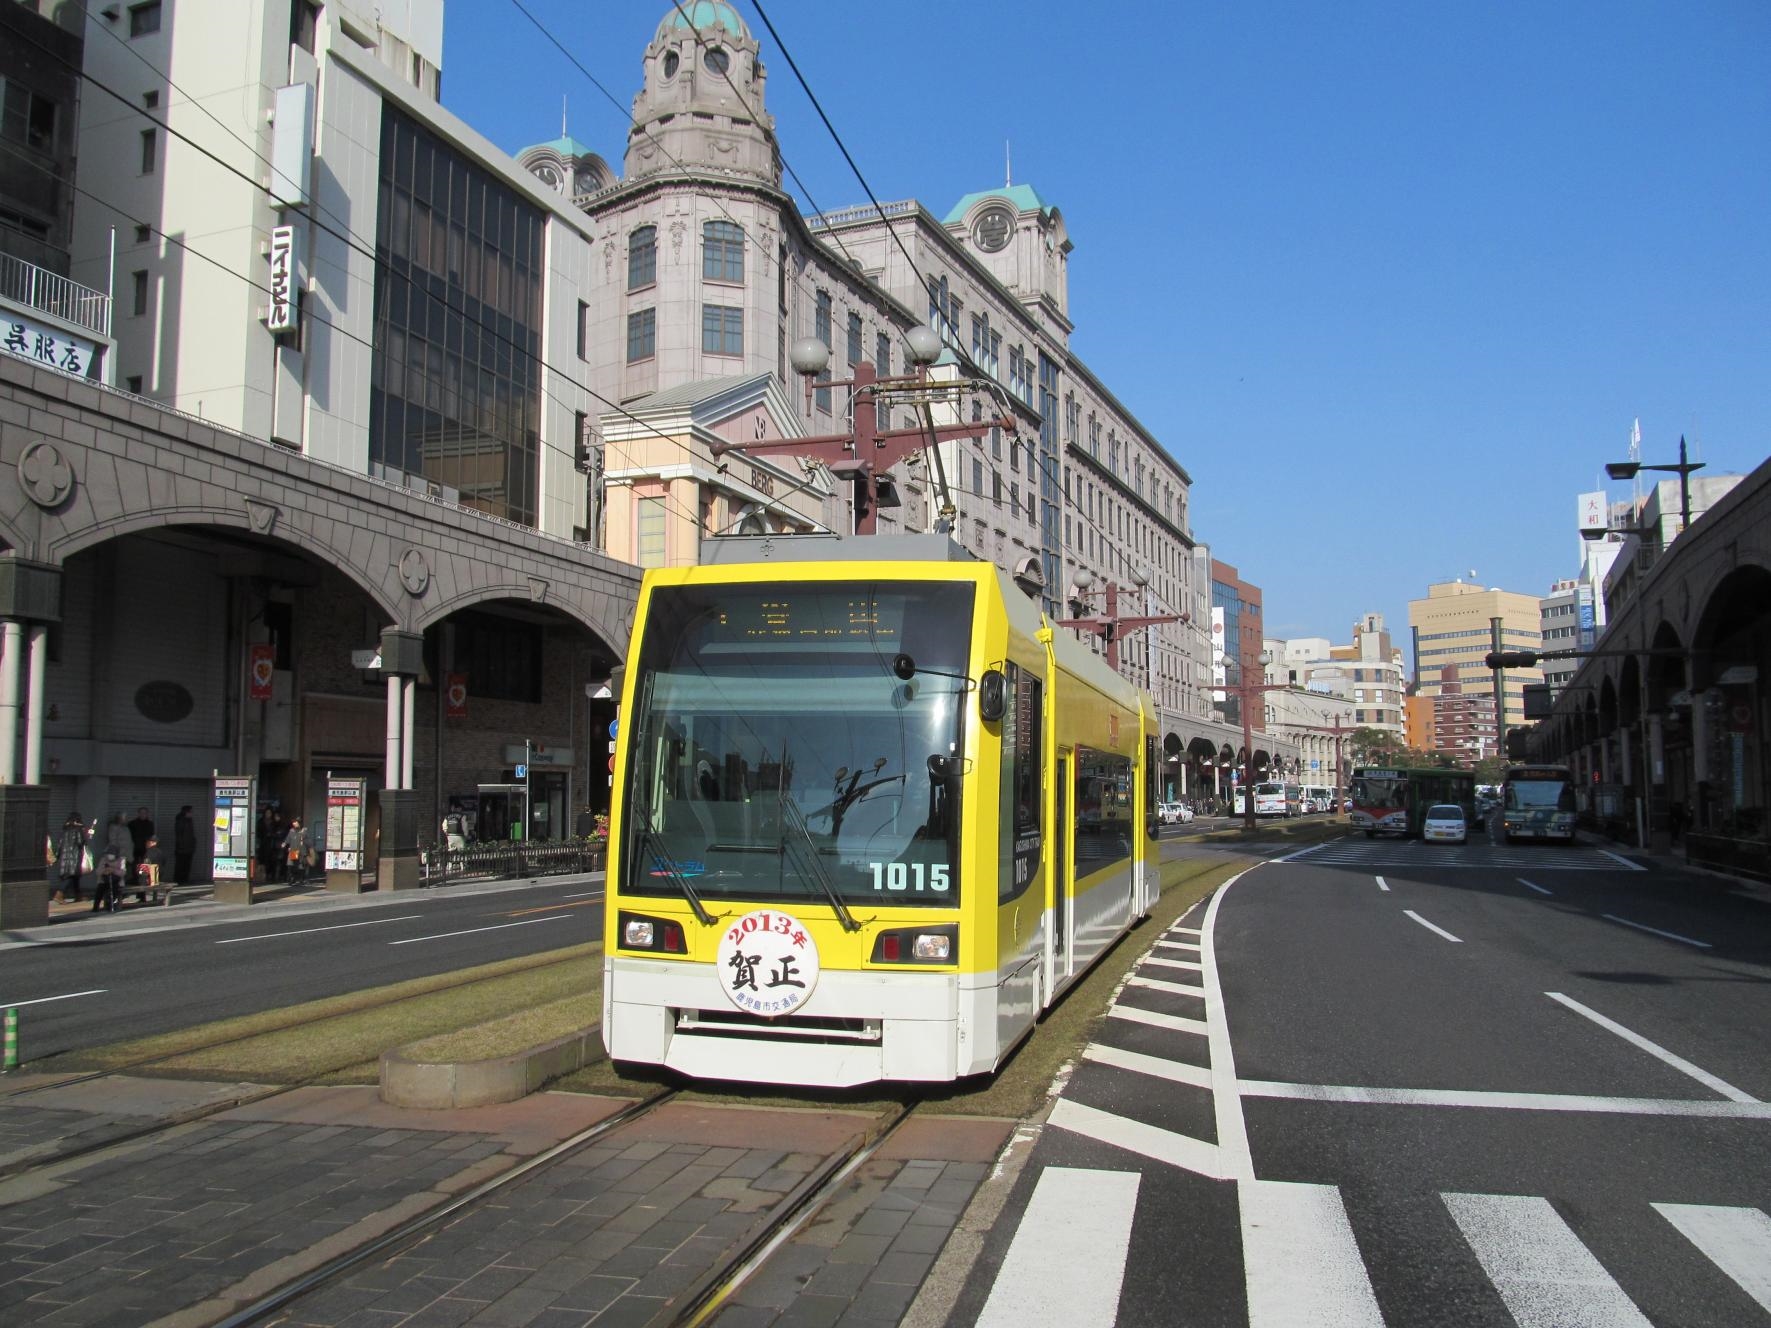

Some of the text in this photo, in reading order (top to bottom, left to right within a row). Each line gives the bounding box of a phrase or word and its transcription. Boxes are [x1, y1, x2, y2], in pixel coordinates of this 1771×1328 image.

[271, 230, 290, 325] ニイナビル
[4, 322, 82, 373] 呉服店
[751, 468, 774, 496] BERG
[869, 862, 950, 892] 1015
[1015, 857, 1028, 885] 1015
[728, 913, 808, 950] 2013年
[728, 949, 806, 992] 賀正
[735, 991, 799, 1012] 鹿児島市交通局
